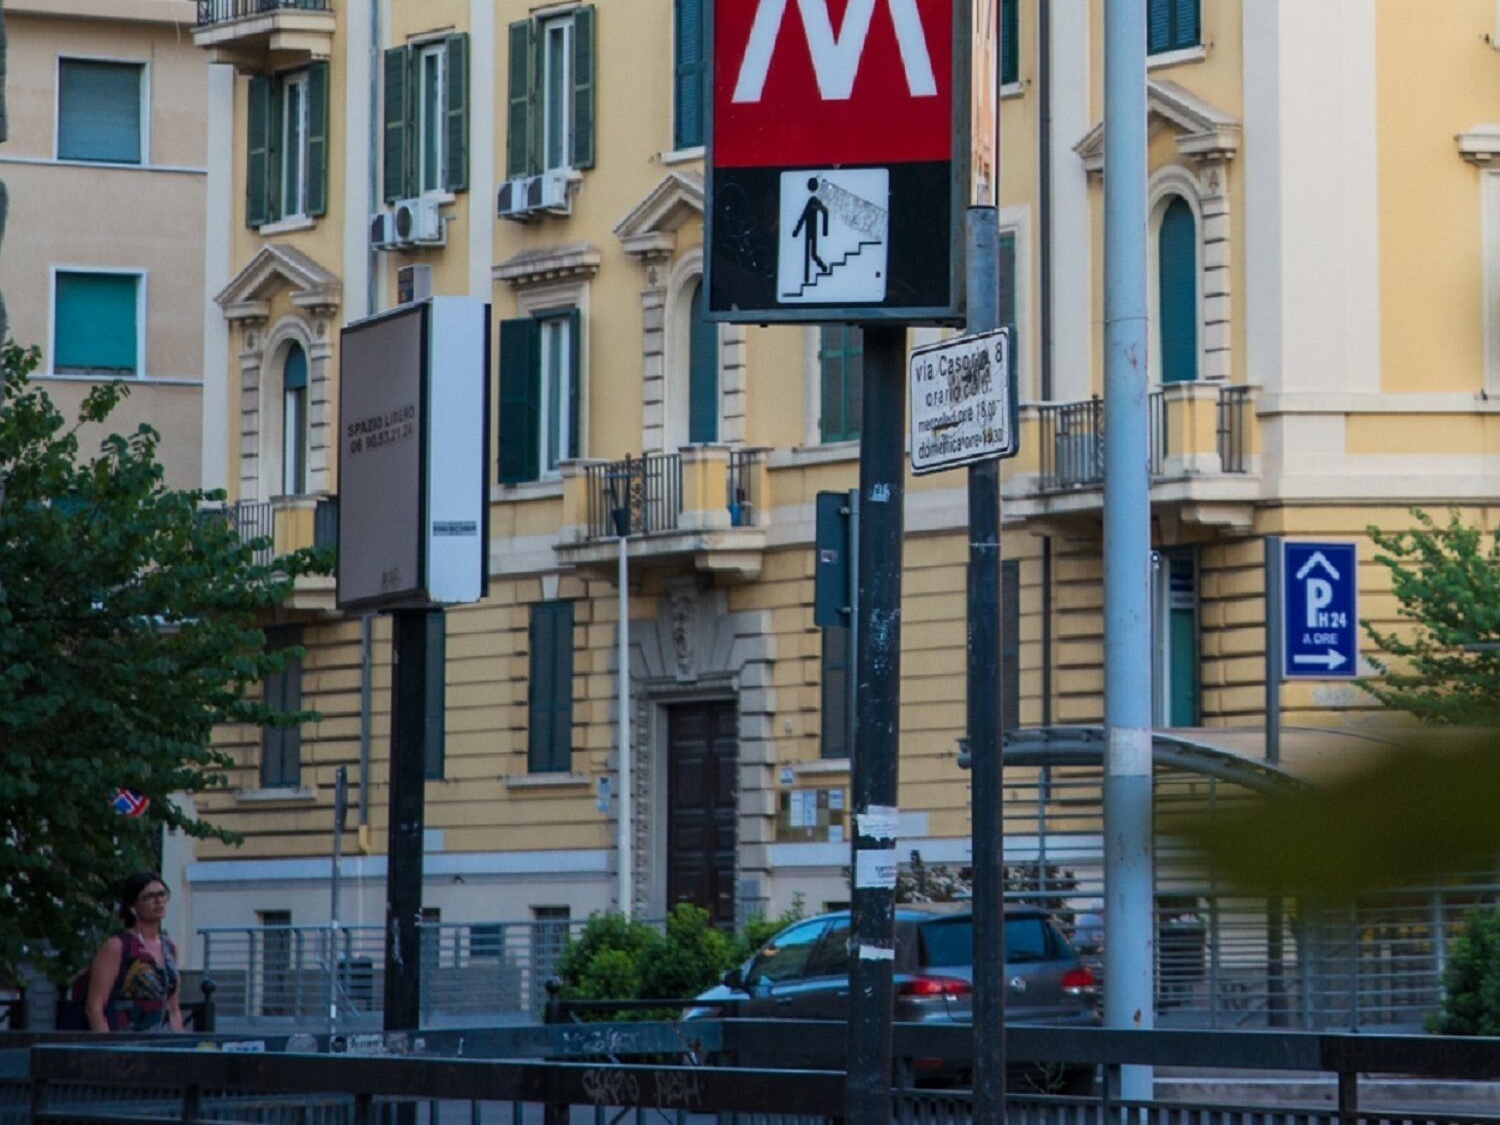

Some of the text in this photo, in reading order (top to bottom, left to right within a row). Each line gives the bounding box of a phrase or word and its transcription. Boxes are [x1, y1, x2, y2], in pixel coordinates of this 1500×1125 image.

[916, 359, 933, 382] via
[995, 342, 1003, 364] 8
[926, 381, 960, 406] orario
[348, 405, 415, 437] SPAZIO LIBERO
[351, 437, 362, 453] 06
[1307, 578, 1333, 628] P
[1313, 632, 1338, 645] ORE
